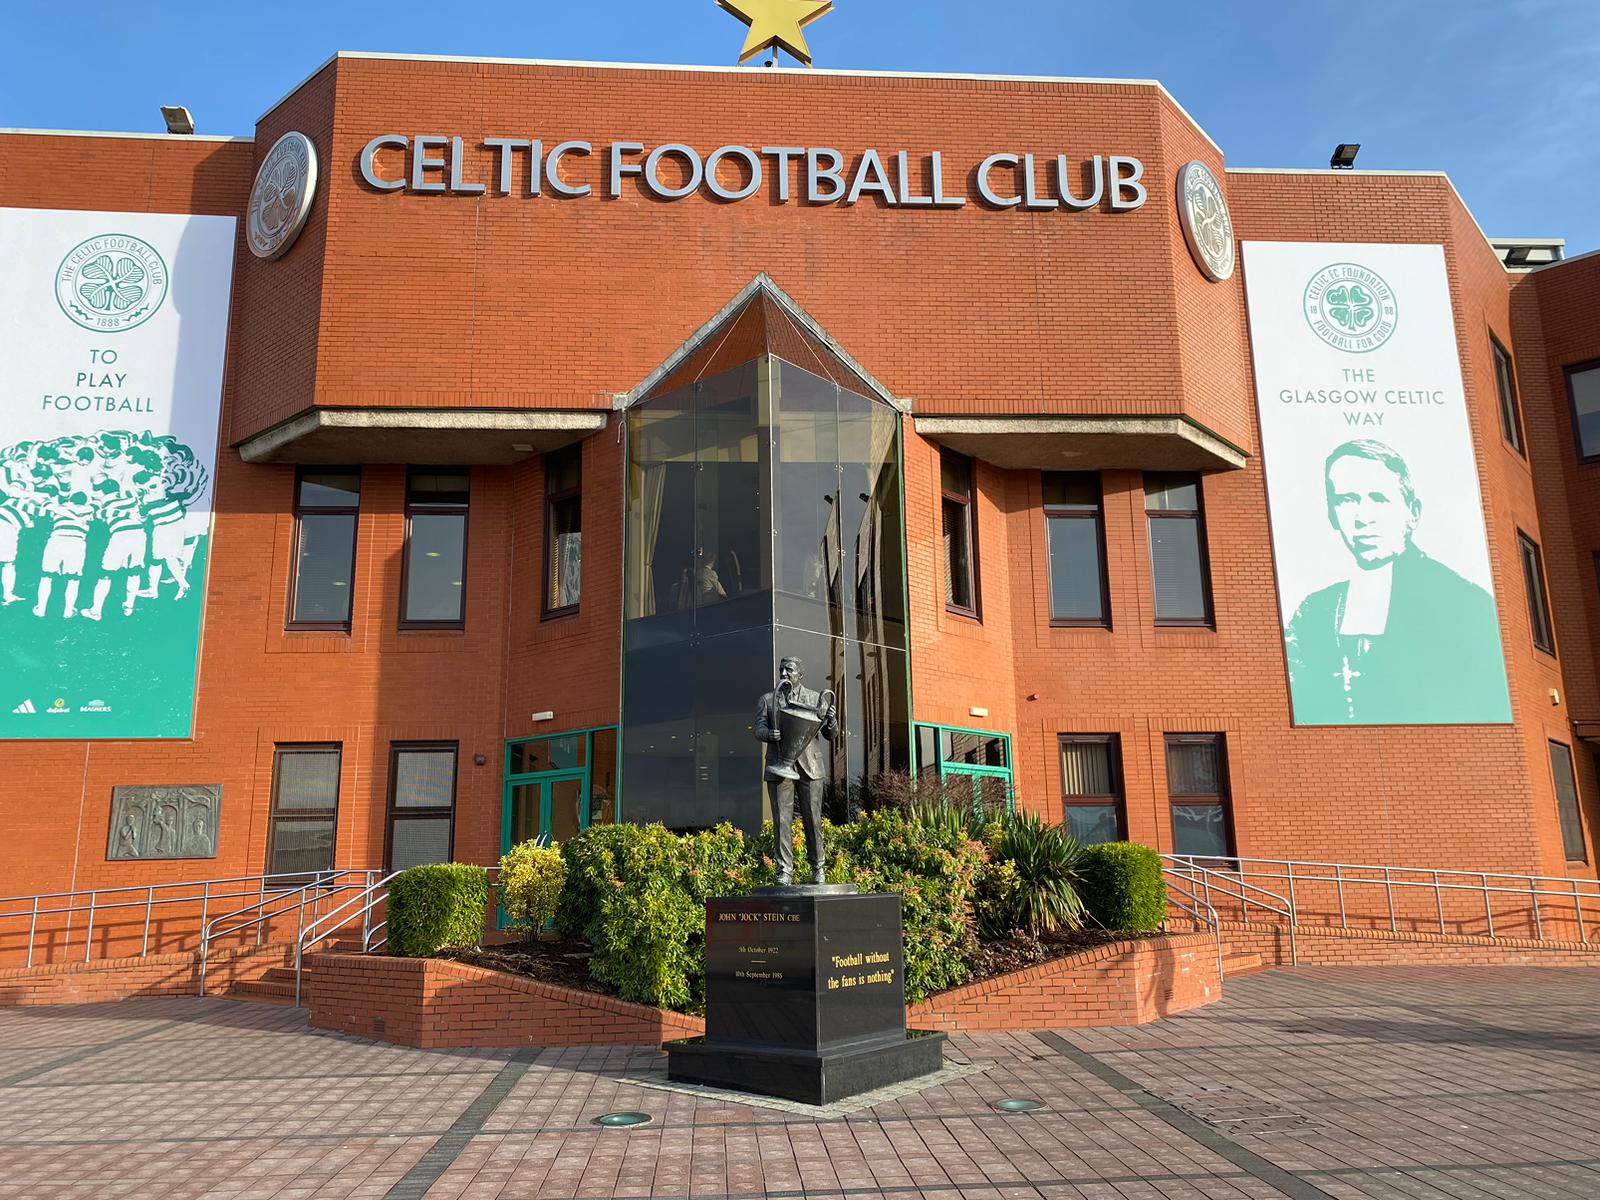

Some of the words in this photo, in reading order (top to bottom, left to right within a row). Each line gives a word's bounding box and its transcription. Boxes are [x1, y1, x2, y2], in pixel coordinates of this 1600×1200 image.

[359, 134, 593, 199] CELTIC
[610, 141, 967, 209] FOOTBALL
[975, 152, 1148, 212] CLUB
[61, 264, 74, 282] THE
[72, 241, 102, 264] CELTIC
[104, 238, 153, 262] FOOTBALL
[148, 259, 162, 285] CLUB
[1308, 274, 1329, 300] CELTIC
[1329, 268, 1340, 279] FC
[1342, 267, 1391, 301] FOUNDATION
[96, 317, 120, 327] 1888
[1313, 319, 1353, 349] FOOTBALL
[1355, 338, 1374, 350] FOR
[1373, 320, 1393, 343] GOOD
[89, 349, 118, 365] TO
[76, 372, 128, 388] PLAY
[1341, 368, 1375, 383] THE
[42, 395, 154, 413] FOOTBALL
[1279, 389, 1377, 404] GLASGOW
[1384, 390, 1445, 405] CELTIC
[1343, 412, 1385, 426] WAY
[718, 912, 737, 922] JOHN
[763, 912, 785, 922] STEIN
[831, 952, 863, 969] "Football
[865, 951, 890, 964] without
[827, 976, 840, 990] the
[841, 974, 857, 988] fans
[858, 972, 865, 985] is
[867, 969, 895, 985] nothing"
